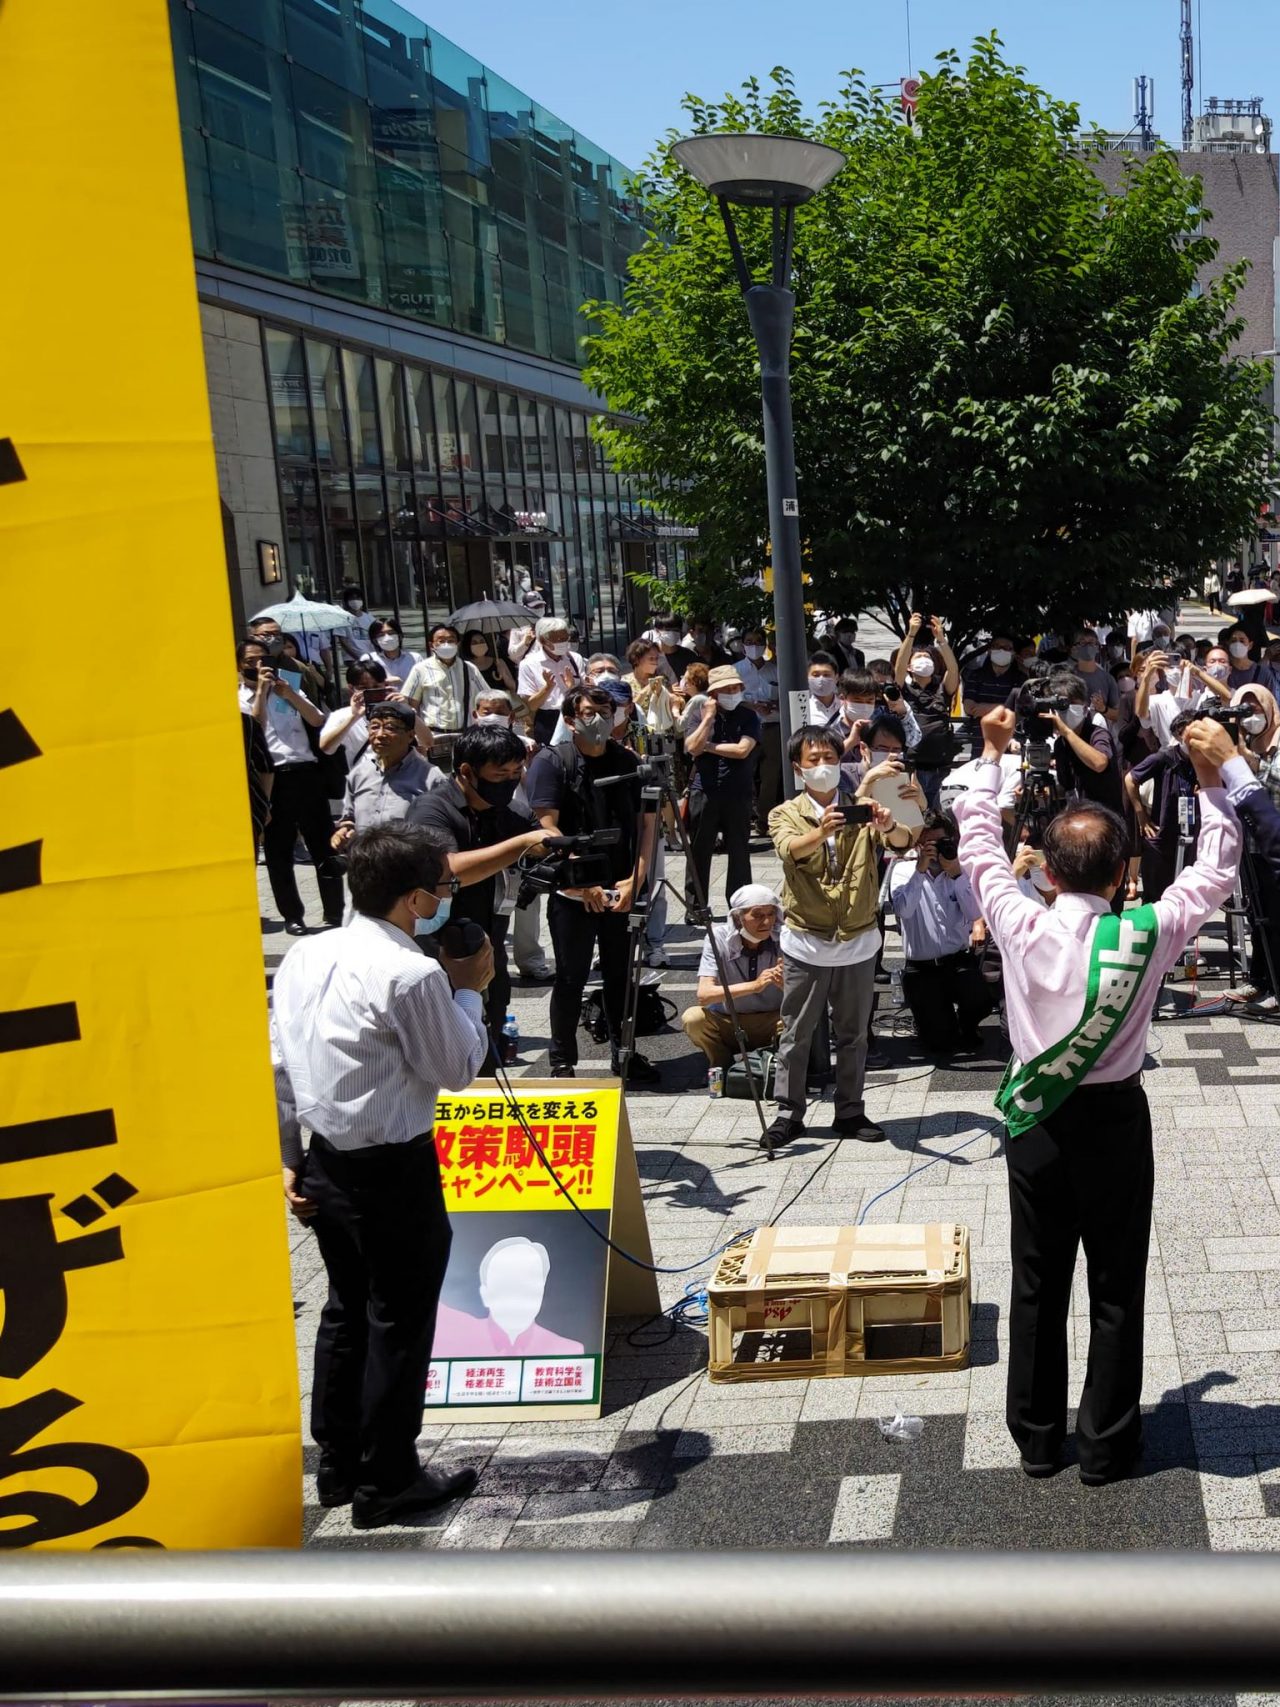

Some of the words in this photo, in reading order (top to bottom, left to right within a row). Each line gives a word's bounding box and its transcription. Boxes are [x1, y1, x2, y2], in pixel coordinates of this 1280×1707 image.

[466, 1368, 505, 1378] 経済再生
[536, 1366, 575, 1377] 教育科学
[465, 1379, 504, 1389] 格差是正
[535, 1377, 574, 1388] 技術立国
